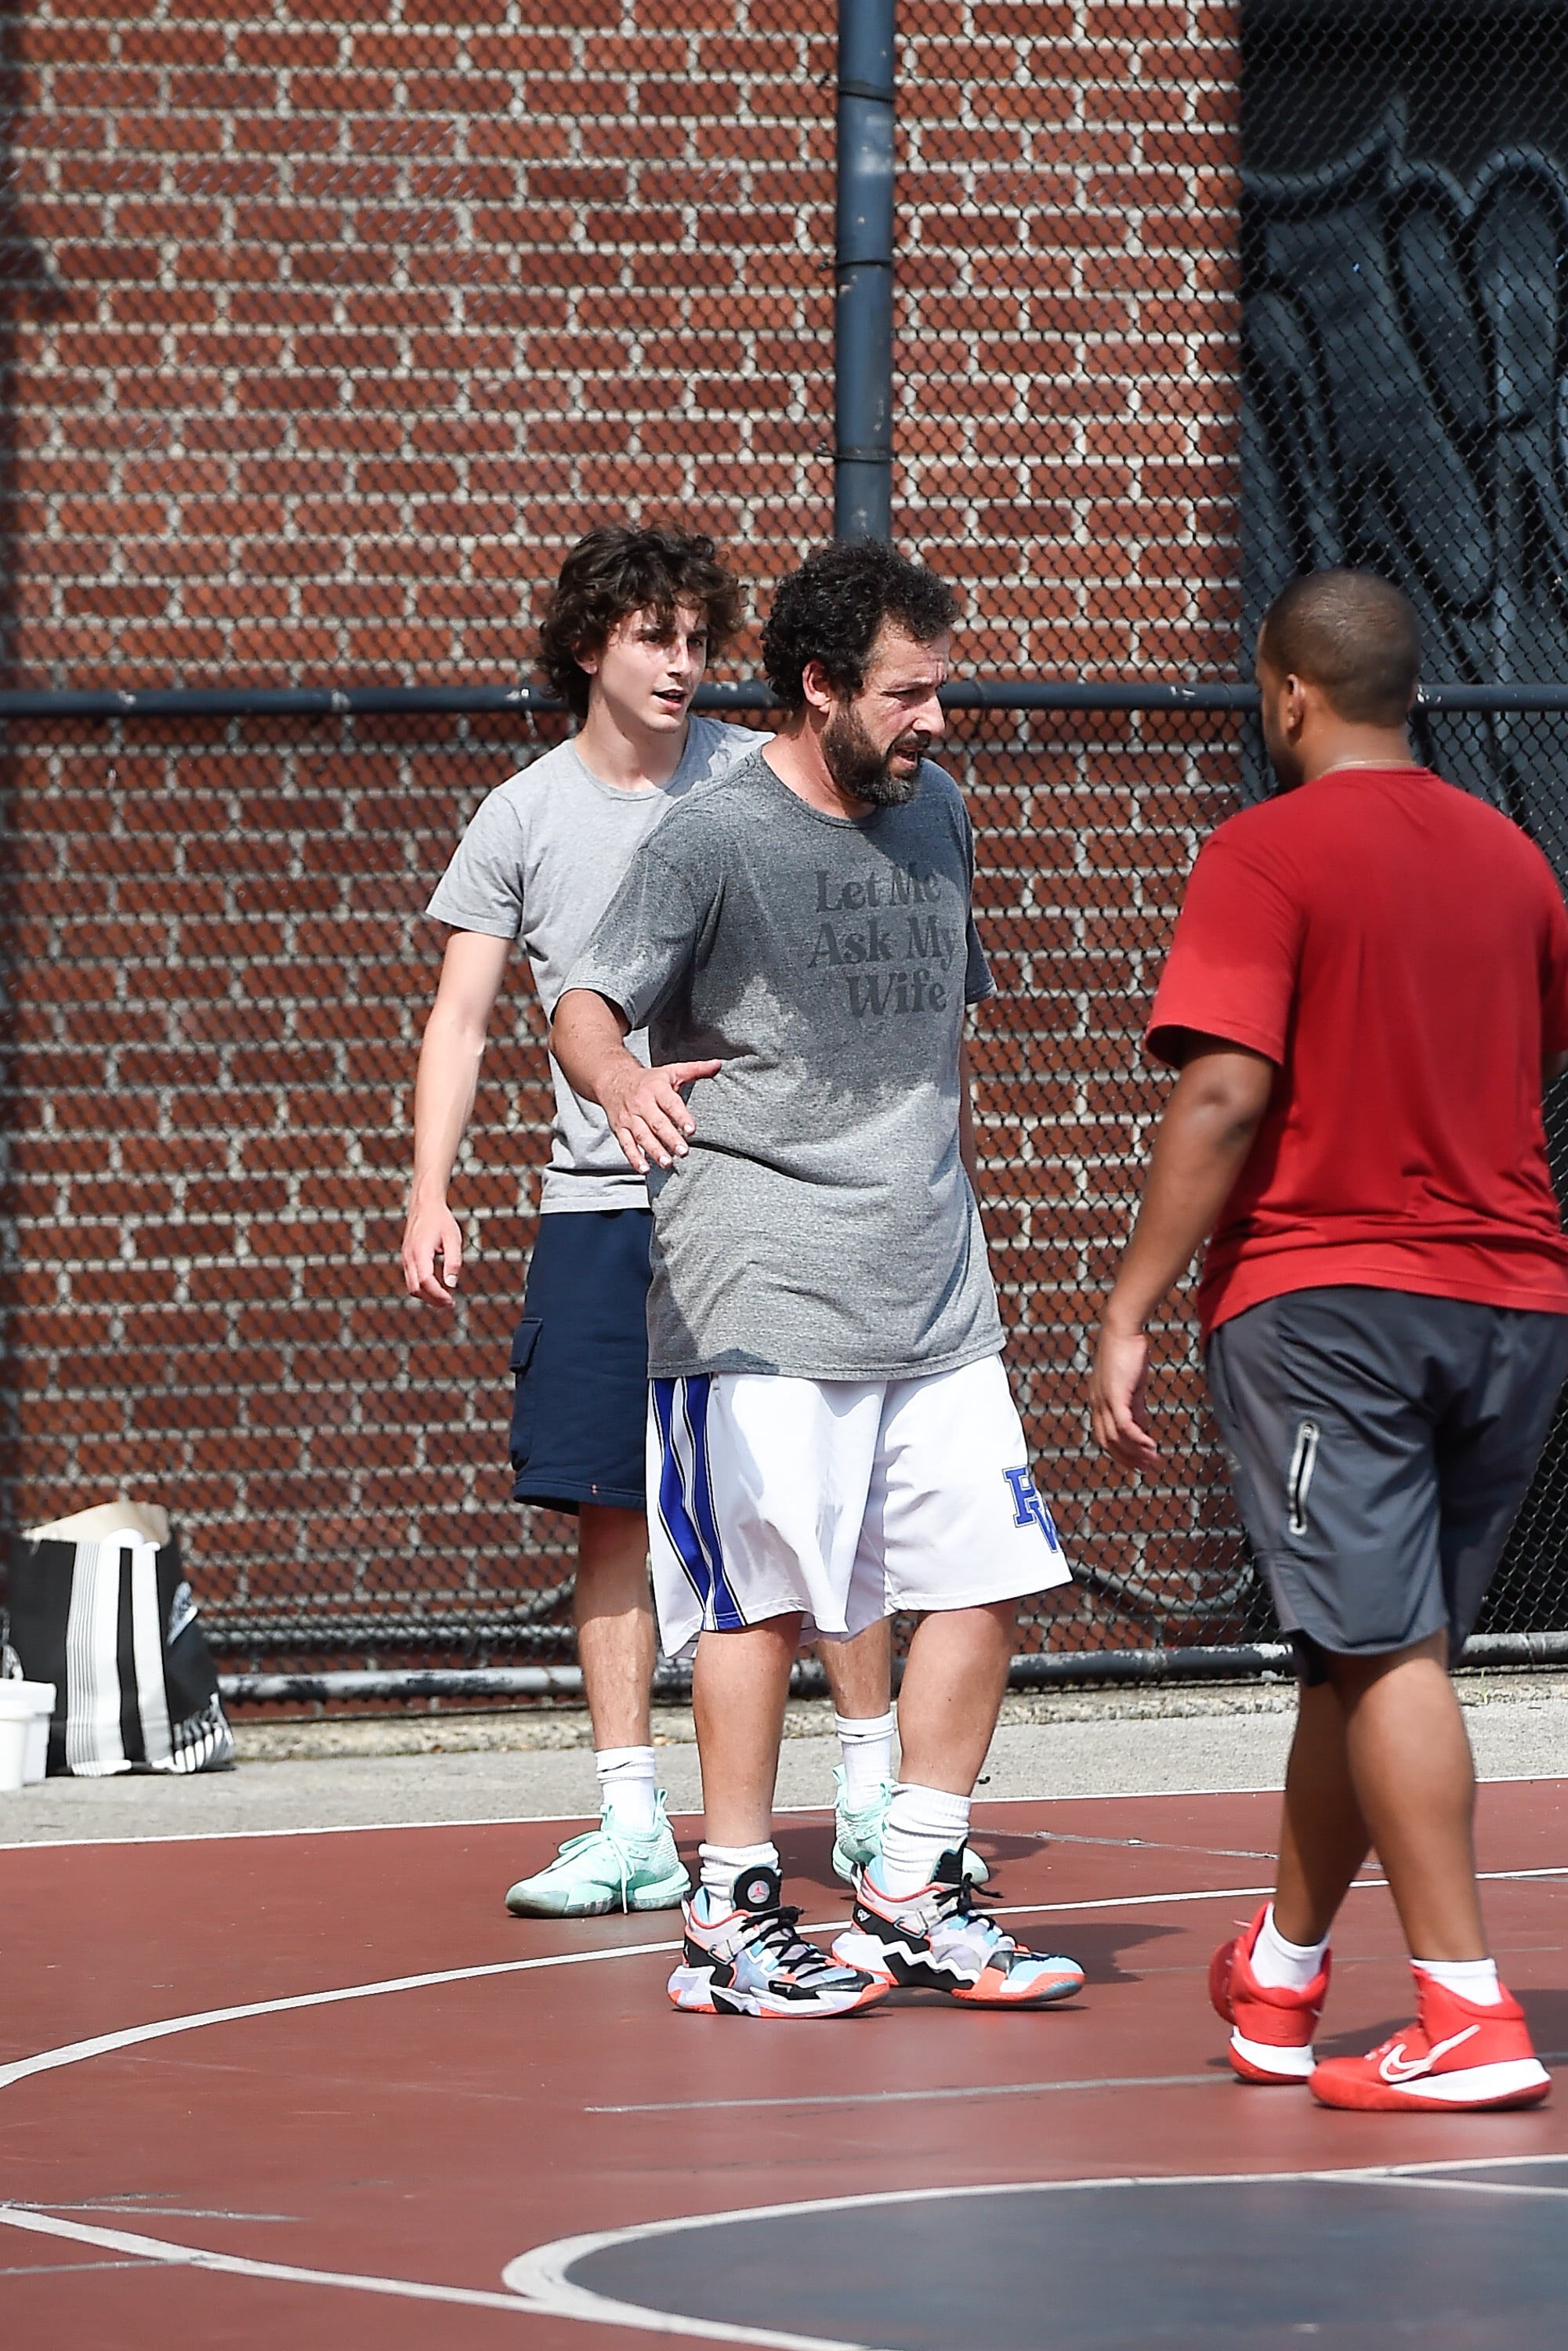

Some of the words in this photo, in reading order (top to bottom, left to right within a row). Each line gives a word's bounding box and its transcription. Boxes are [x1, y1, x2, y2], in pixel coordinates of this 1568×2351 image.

[815, 869, 880, 912] Let
[889, 862, 942, 906] Me
[808, 919, 893, 969] Ask
[906, 914, 957, 972] My
[845, 969, 947, 1019] Wife
